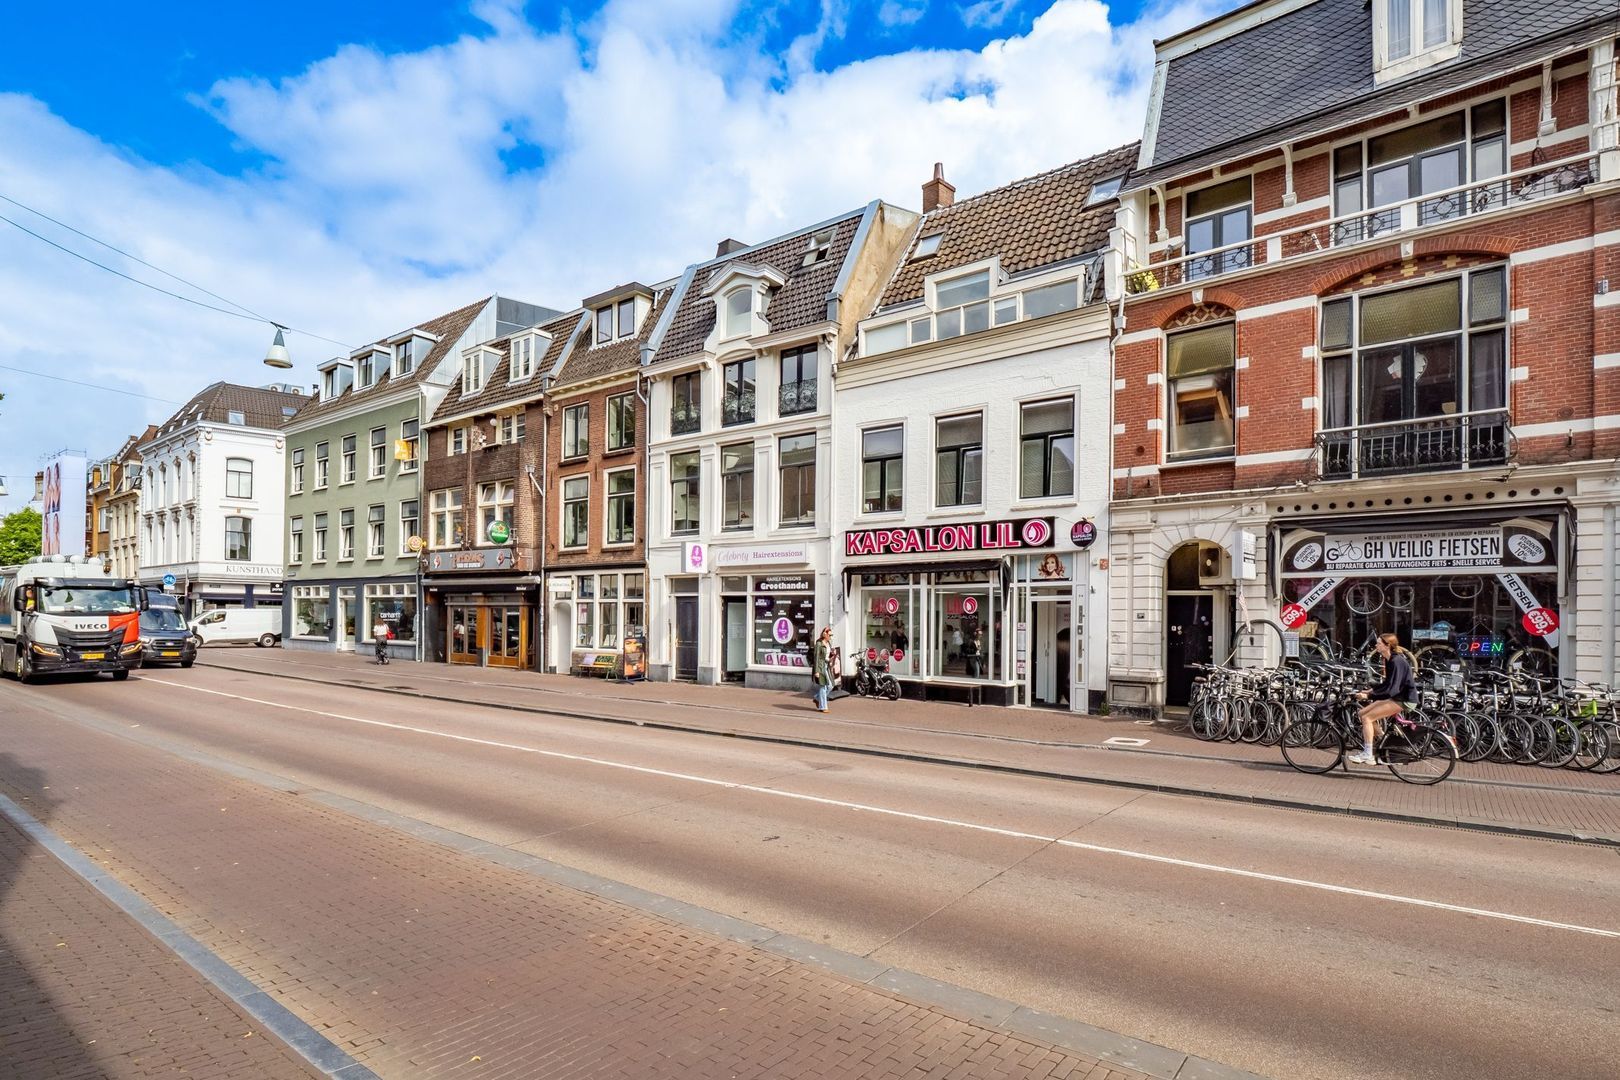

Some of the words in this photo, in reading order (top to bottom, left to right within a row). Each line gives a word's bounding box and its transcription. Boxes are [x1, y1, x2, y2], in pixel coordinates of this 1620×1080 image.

[1364, 541, 1384, 559] GH
[1389, 539, 1433, 558] VEILIG
[1440, 537, 1500, 556] FIETSEN
[1518, 541, 1537, 557] KORTING
[1519, 536, 1544, 554] STUDENTEN
[752, 550, 803, 559] Hairextensions
[1386, 560, 1431, 568] VERVANGENDE
[760, 582, 808, 590] Groothandel
[1304, 578, 1335, 606] FIETSEN
[1503, 574, 1535, 610] FIETSEN
[1458, 642, 1504, 652] OPEN
